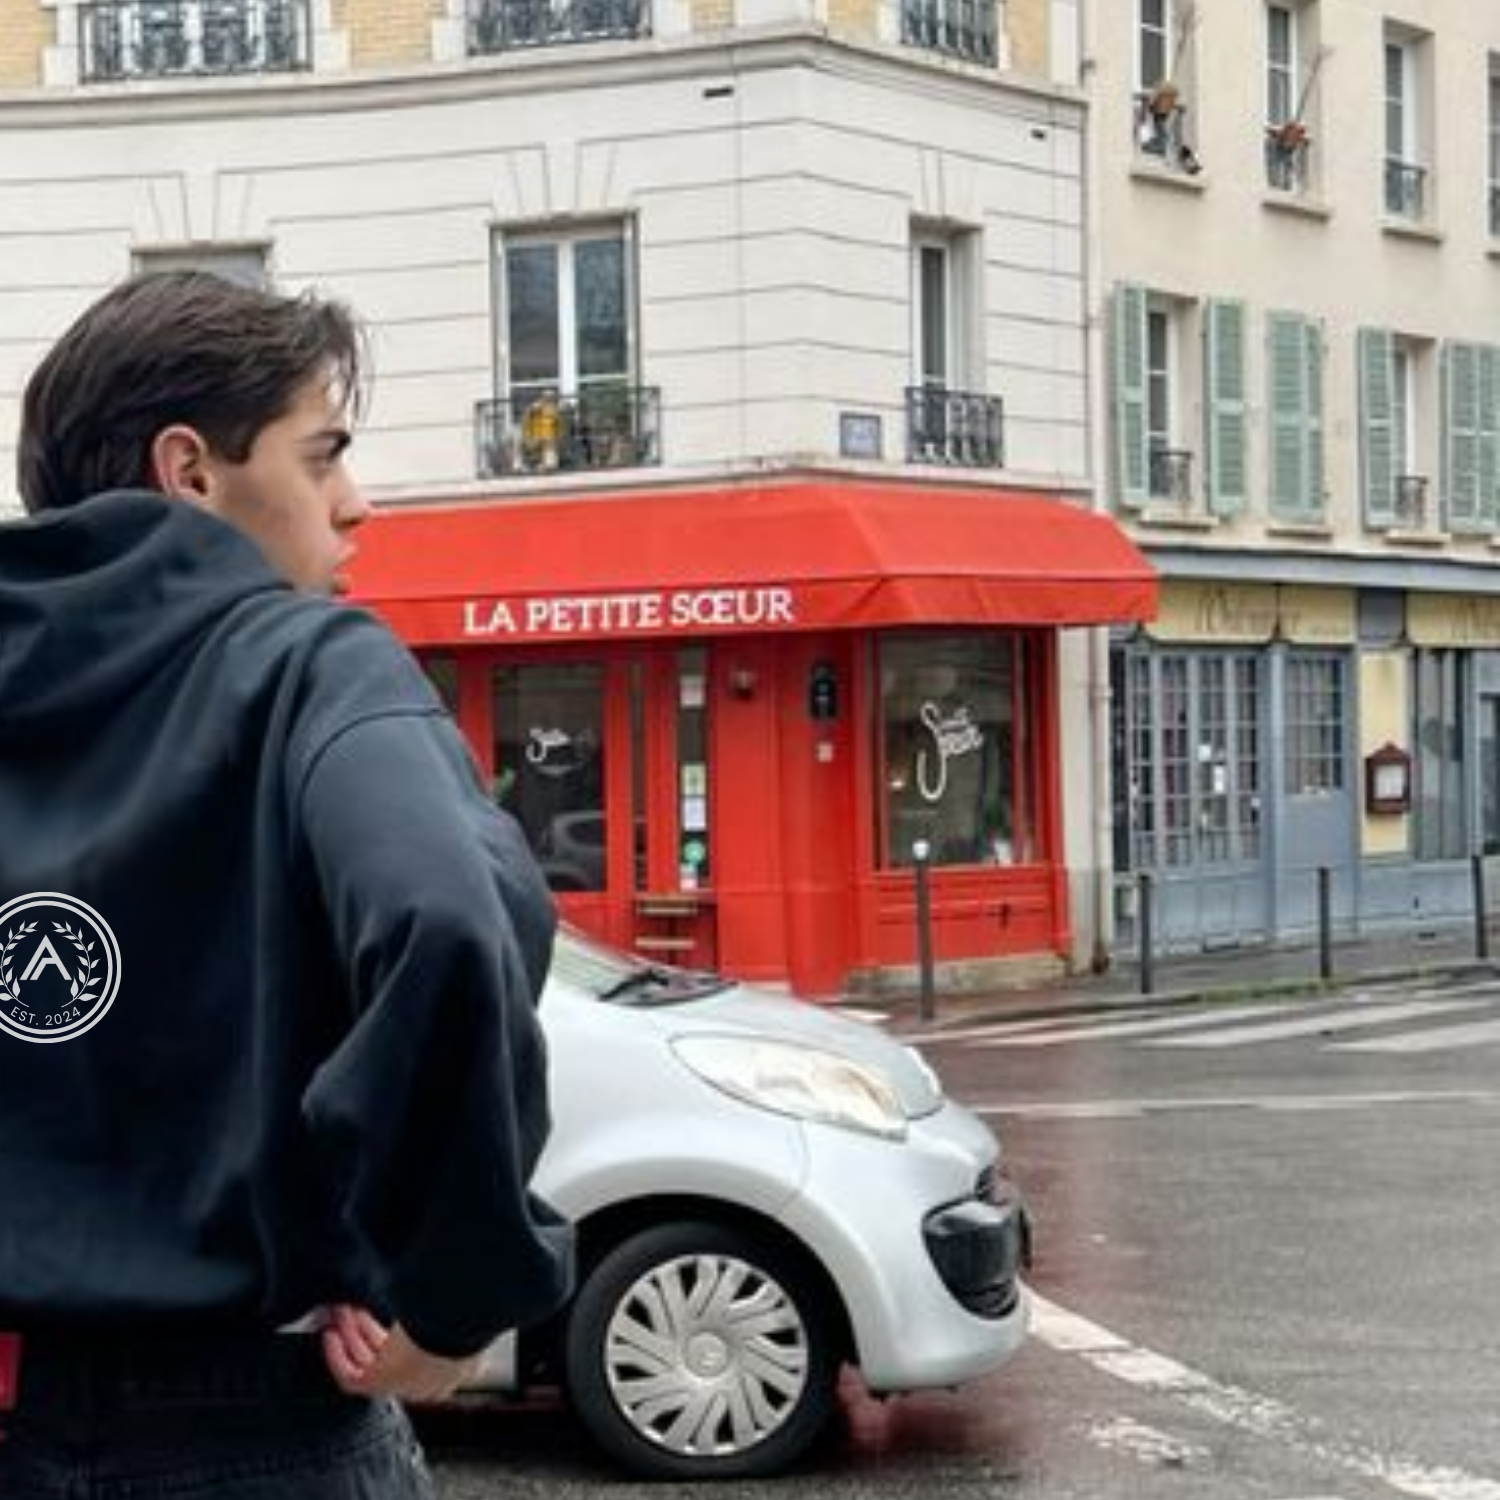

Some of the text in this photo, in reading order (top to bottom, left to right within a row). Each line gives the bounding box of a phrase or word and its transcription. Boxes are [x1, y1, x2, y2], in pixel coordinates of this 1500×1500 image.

[463, 588, 795, 636] LA PETITE SŒUR
[19, 934, 73, 981] A
[10, 1006, 81, 1026] EST. 2024
